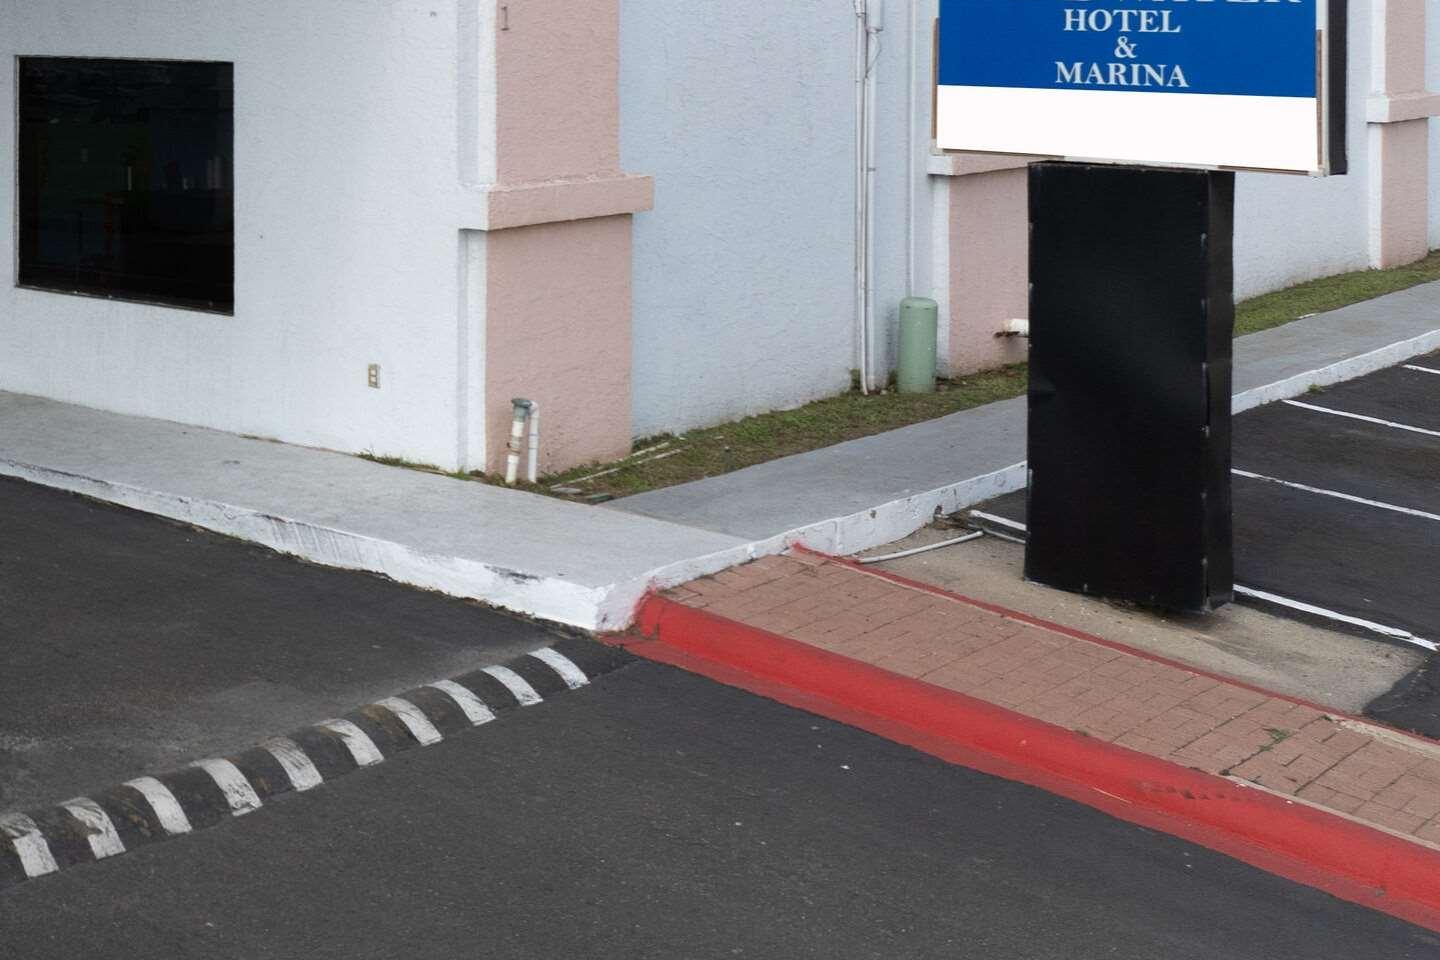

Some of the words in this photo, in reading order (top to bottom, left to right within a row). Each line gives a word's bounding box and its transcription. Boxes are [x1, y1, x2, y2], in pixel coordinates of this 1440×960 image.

[1063, 8, 1181, 33] HOTEL
[1113, 36, 1137, 59] &
[1054, 61, 1190, 88] MARINA
